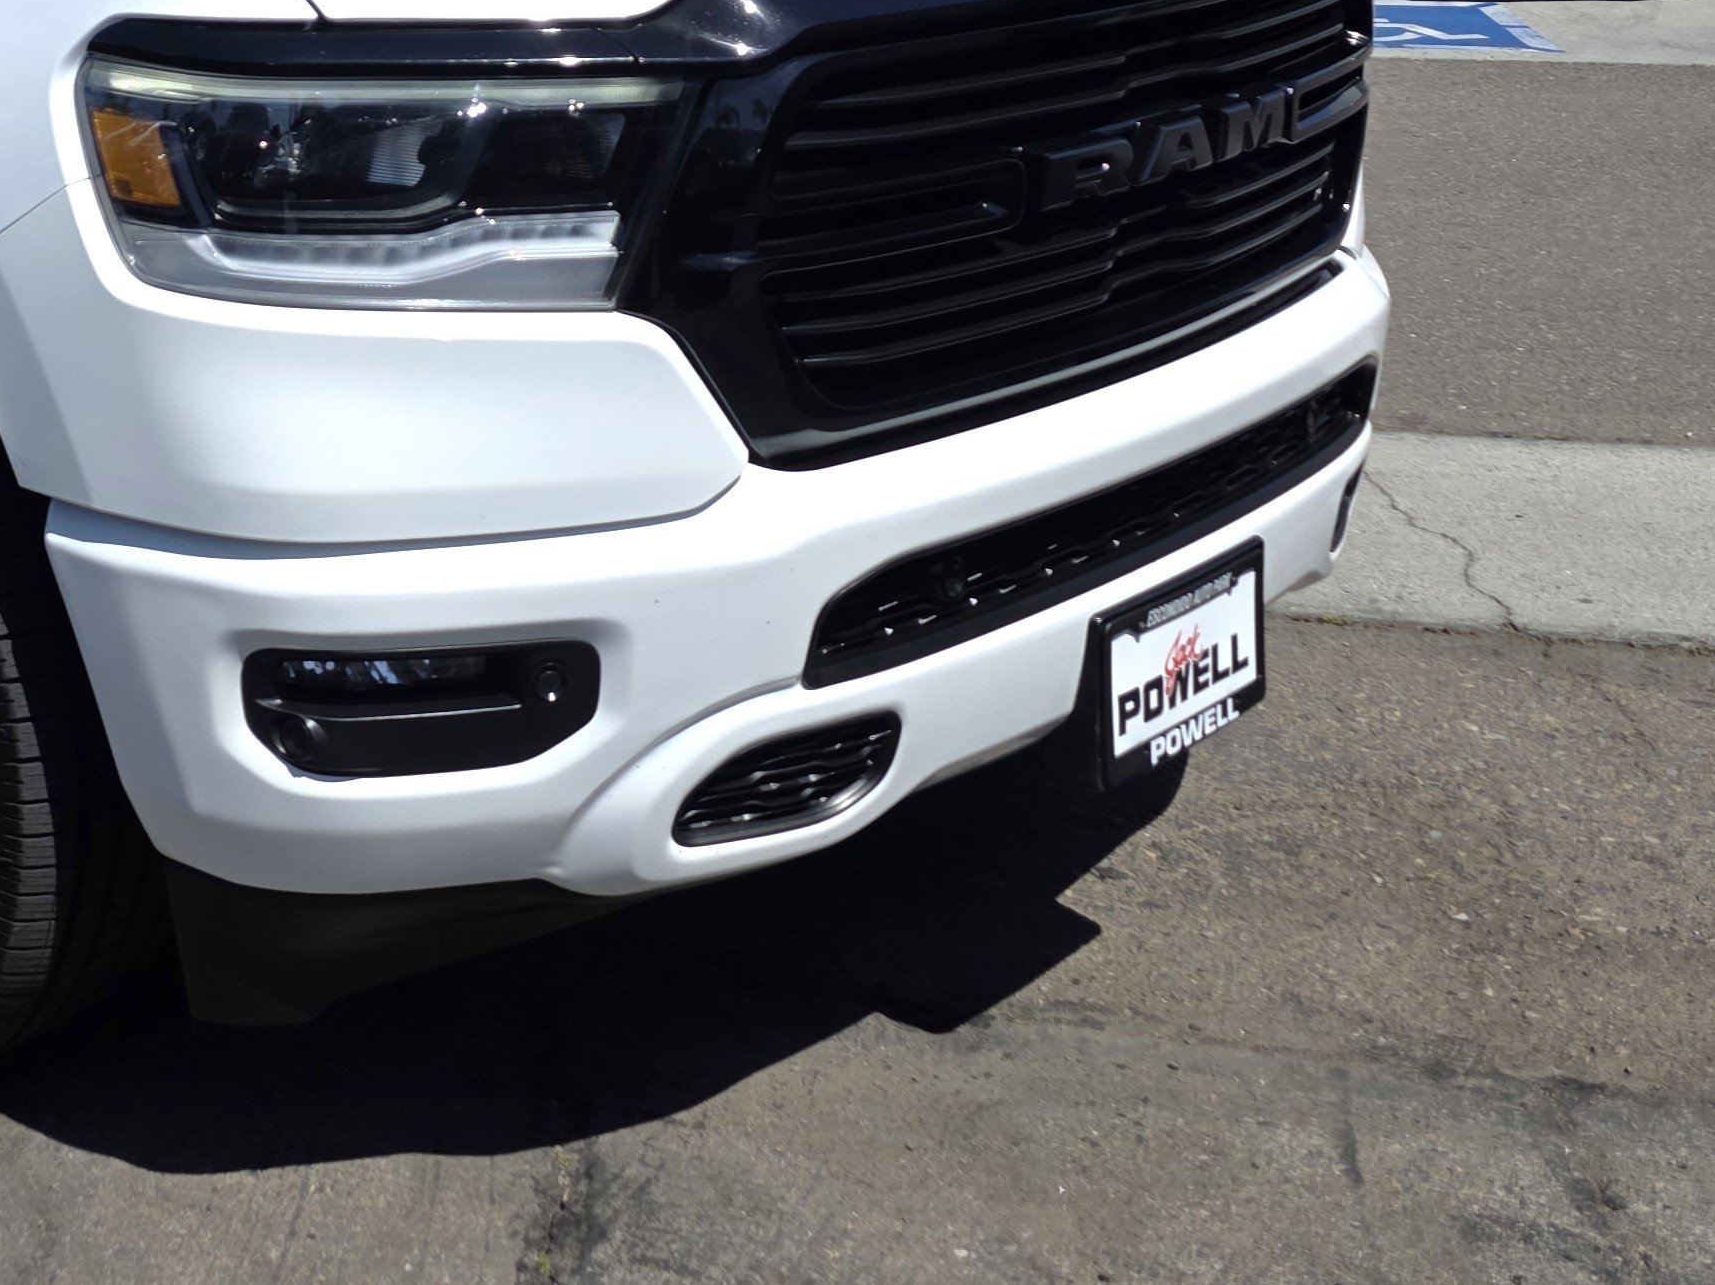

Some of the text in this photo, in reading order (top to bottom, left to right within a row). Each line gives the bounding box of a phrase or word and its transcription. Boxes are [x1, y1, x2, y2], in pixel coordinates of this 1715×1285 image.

[1041, 87, 1287, 211] RAM
[1118, 633, 1249, 737] POWELL
[1150, 697, 1240, 767] POWELL
